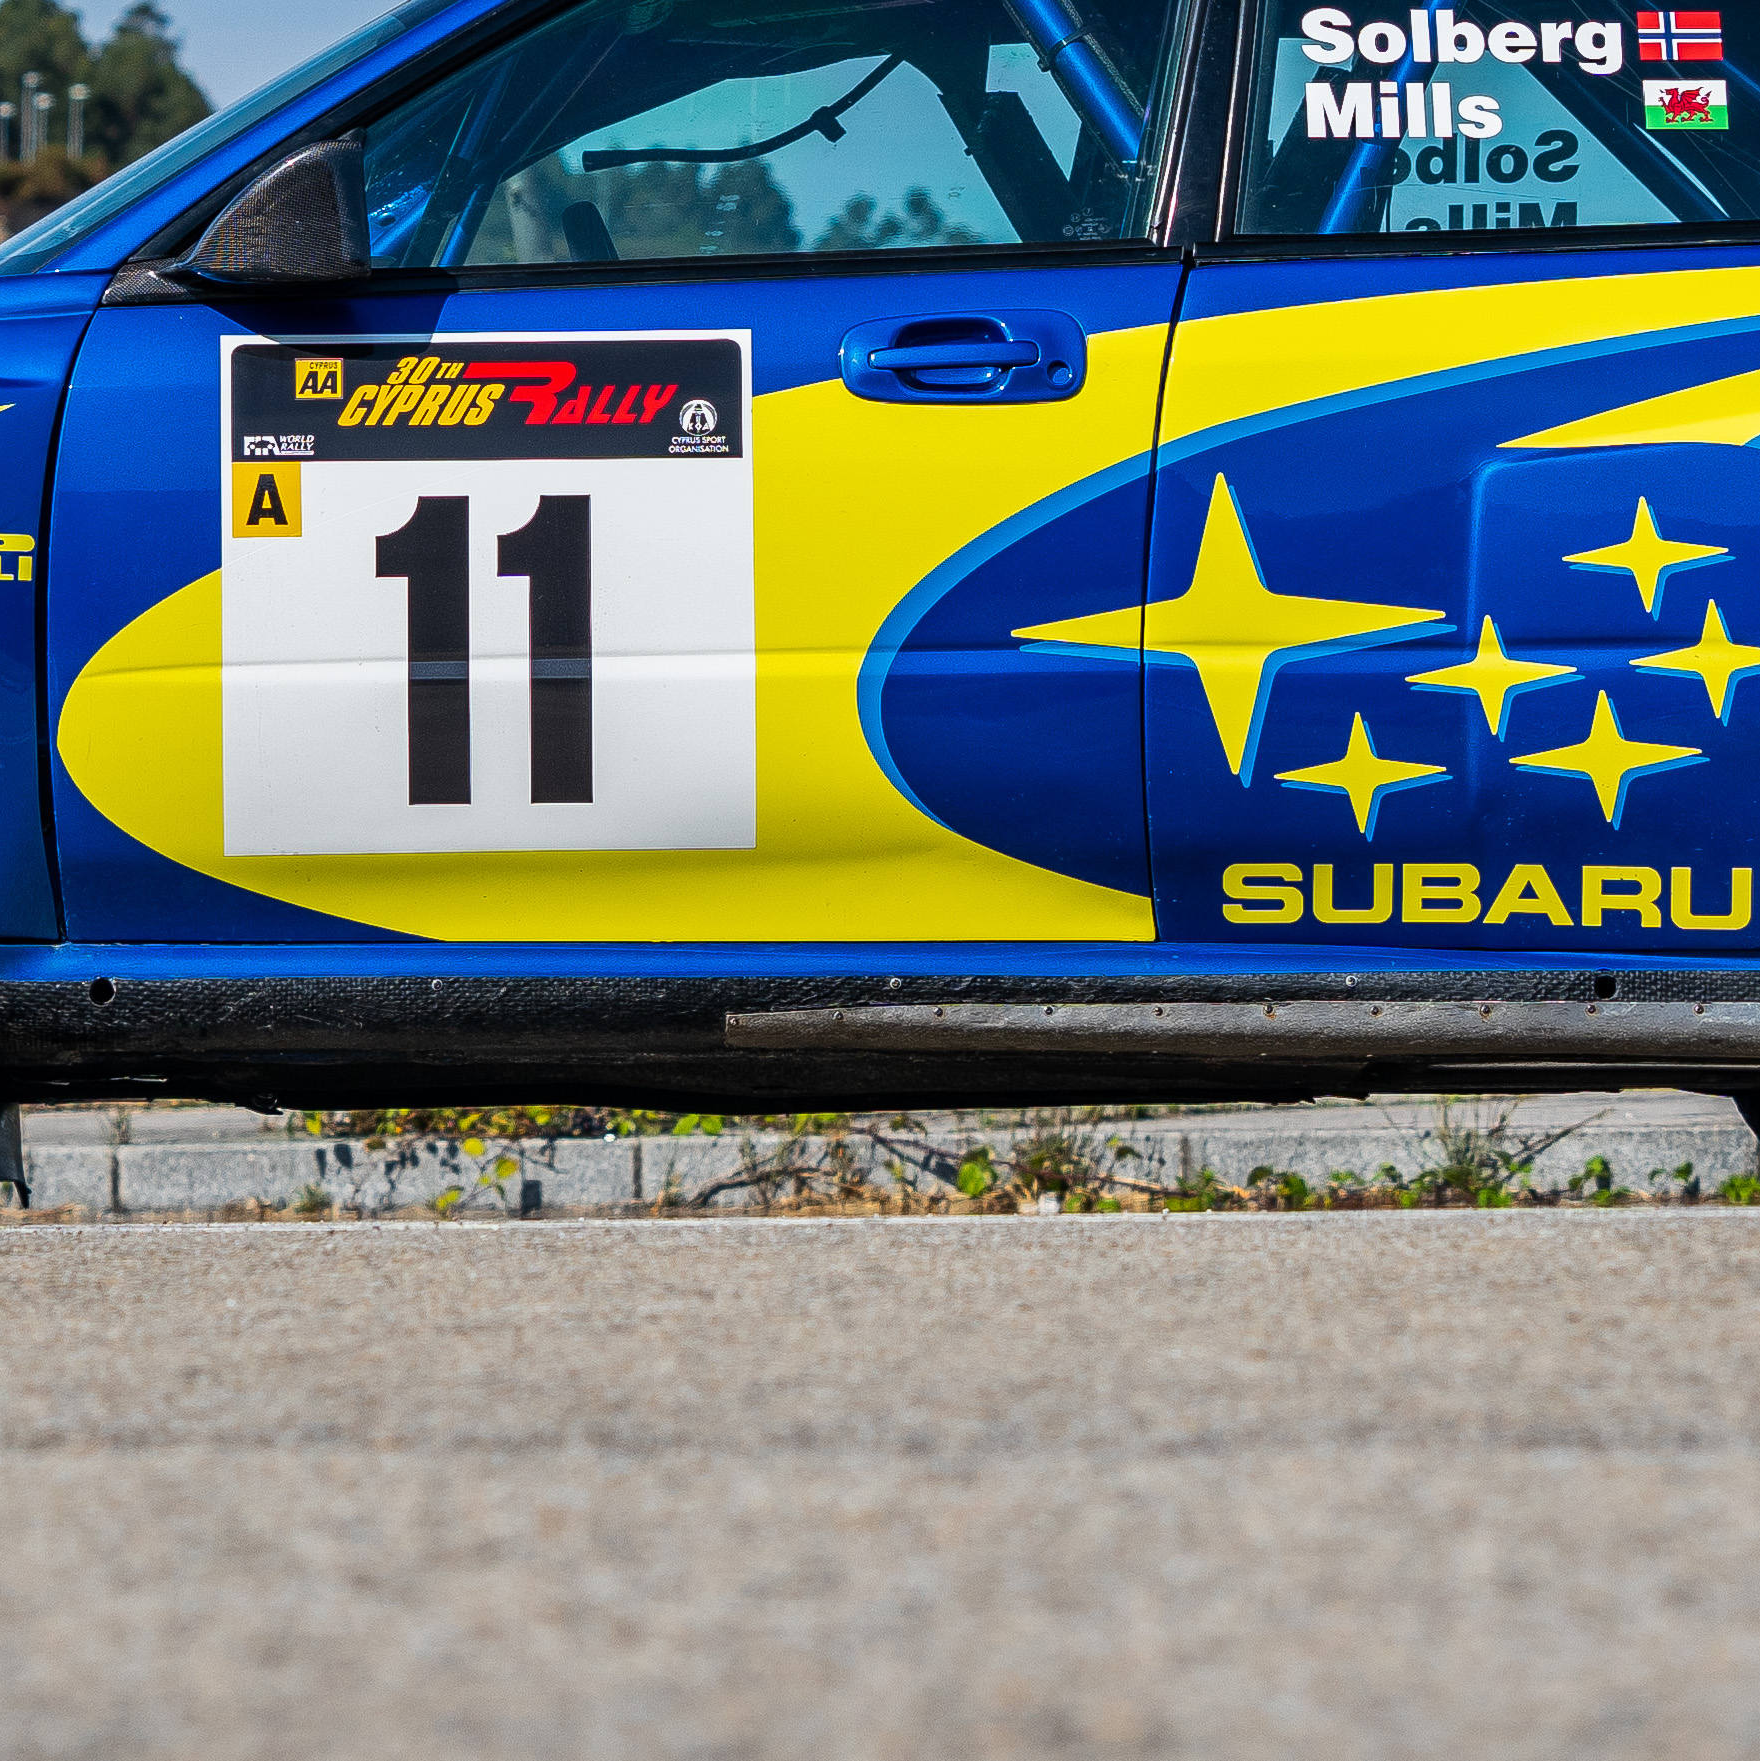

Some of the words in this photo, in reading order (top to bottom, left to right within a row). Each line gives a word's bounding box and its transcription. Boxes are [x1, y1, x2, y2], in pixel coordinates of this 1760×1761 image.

[1300, 6, 1624, 76] Solberg
[1305, 80, 1505, 139] Mills
[298, 370, 338, 395] AA
[309, 361, 338, 370] CYPRUS
[337, 383, 506, 427] CYPRUS
[462, 361, 679, 425] RALLY
[279, 434, 315, 443] WORLD
[280, 442, 315, 451] RALLY
[668, 444, 730, 453] ORGANISATION
[671, 436, 701, 445] CYPRUS
[702, 436, 727, 444] SPORT
[246, 473, 289, 526] A
[374, 494, 594, 805] 11
[1221, 861, 1754, 930] SUBARU
